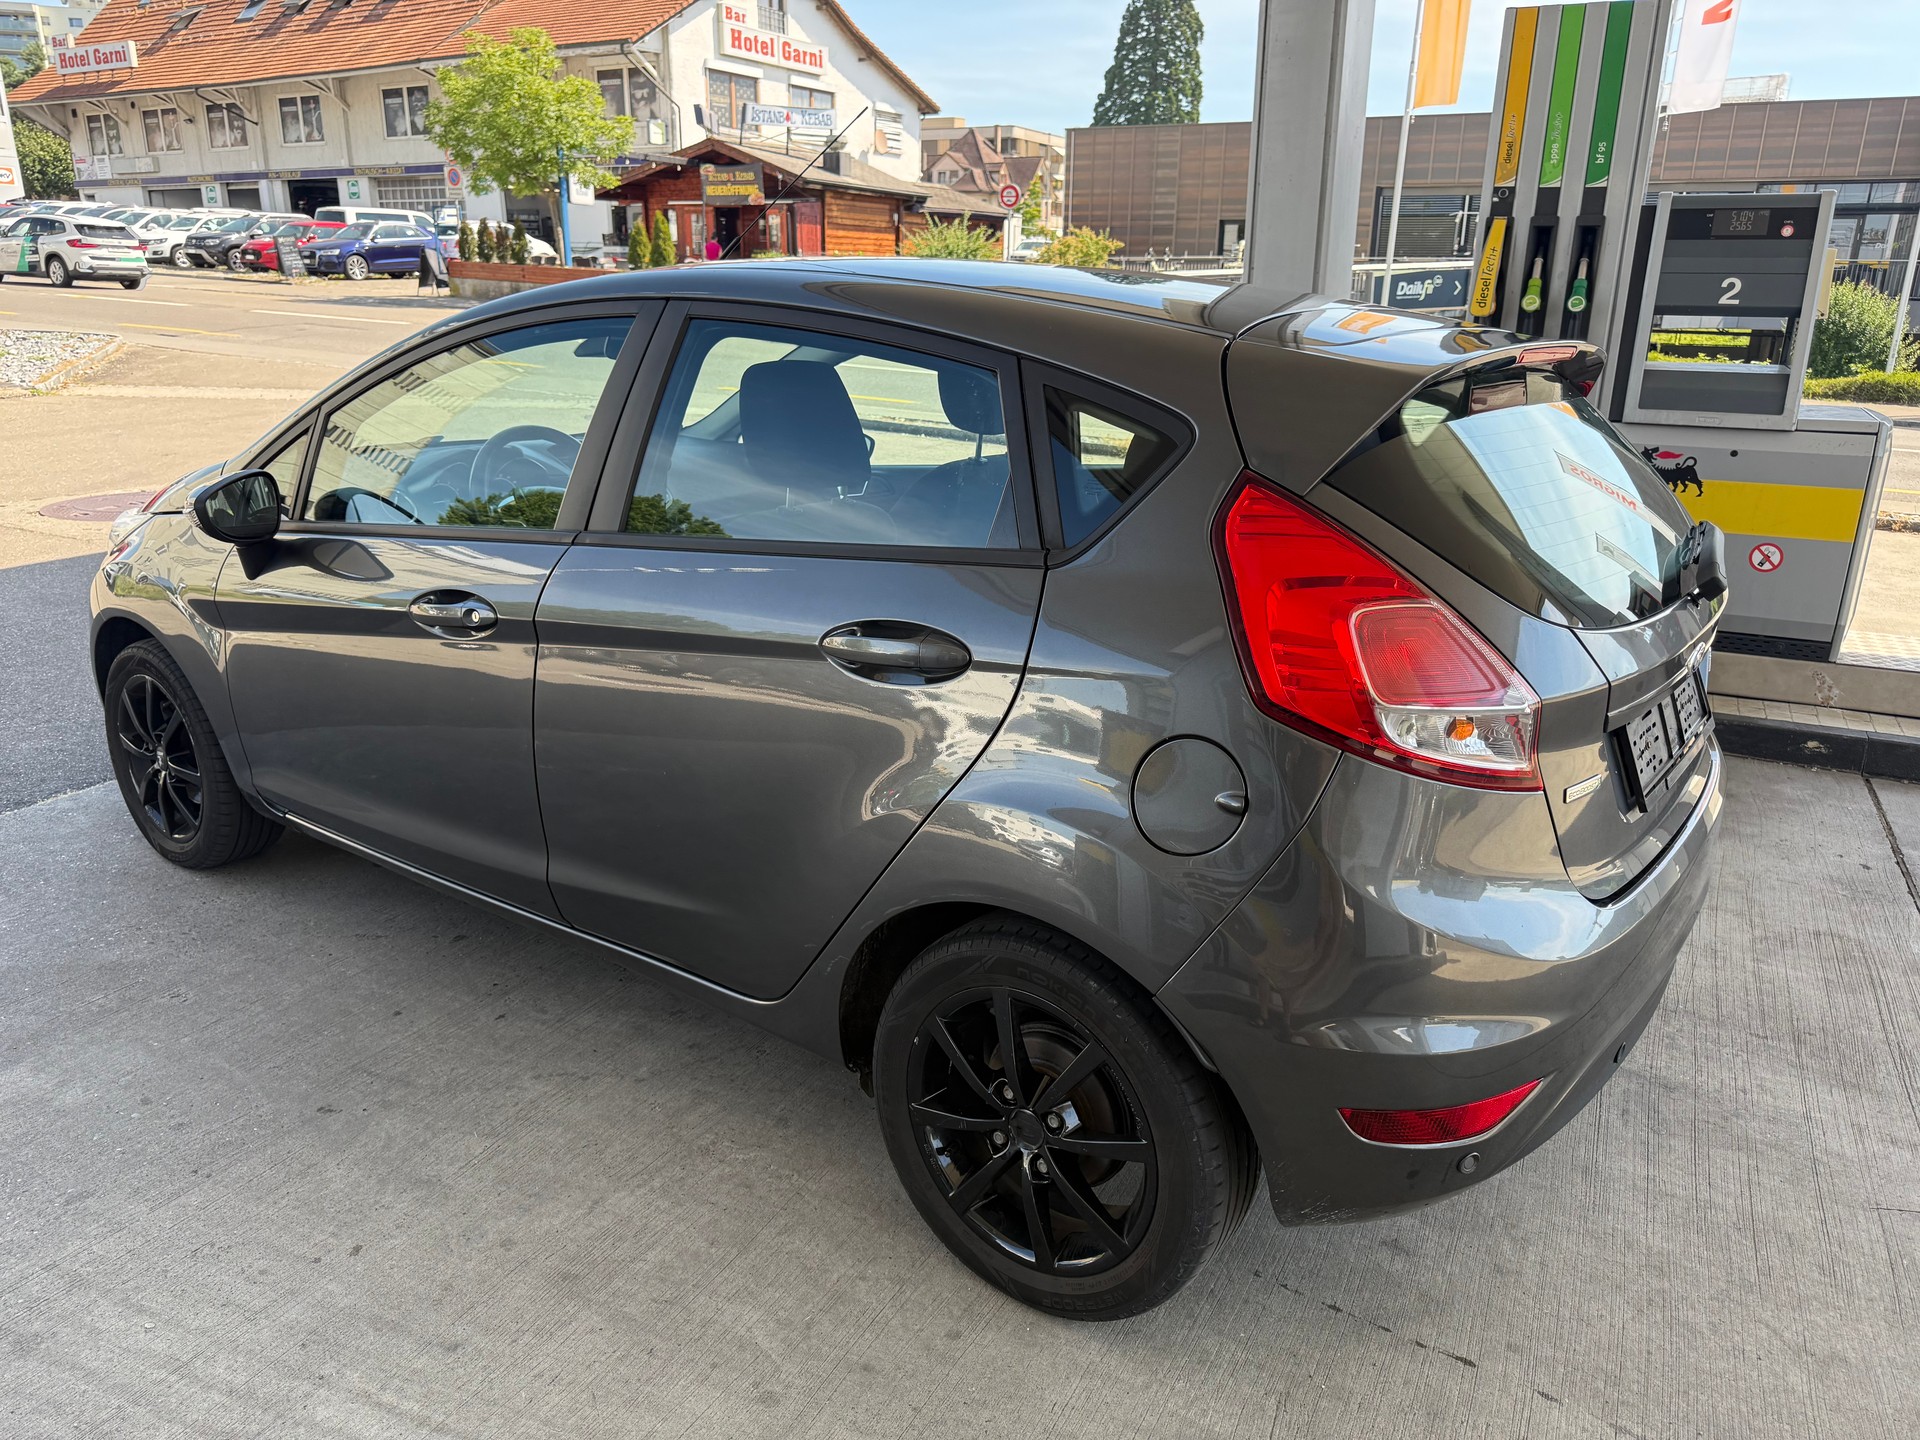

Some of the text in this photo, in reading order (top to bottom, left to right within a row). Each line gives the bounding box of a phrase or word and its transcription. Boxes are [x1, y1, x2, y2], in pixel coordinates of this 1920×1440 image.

[725, 6, 746, 24] Bar
[52, 36, 66, 48] Bar
[730, 28, 823, 69] Hotel Garni
[59, 45, 127, 69] Hotel Garni
[801, 110, 833, 127] KEBAB
[1503, 141, 1514, 164] diesel
[1550, 143, 1560, 165] sp98
[1595, 142, 1607, 164] bf 95
[1475, 246, 1498, 309] diesel Tech+
[1718, 277, 1742, 305] 2
